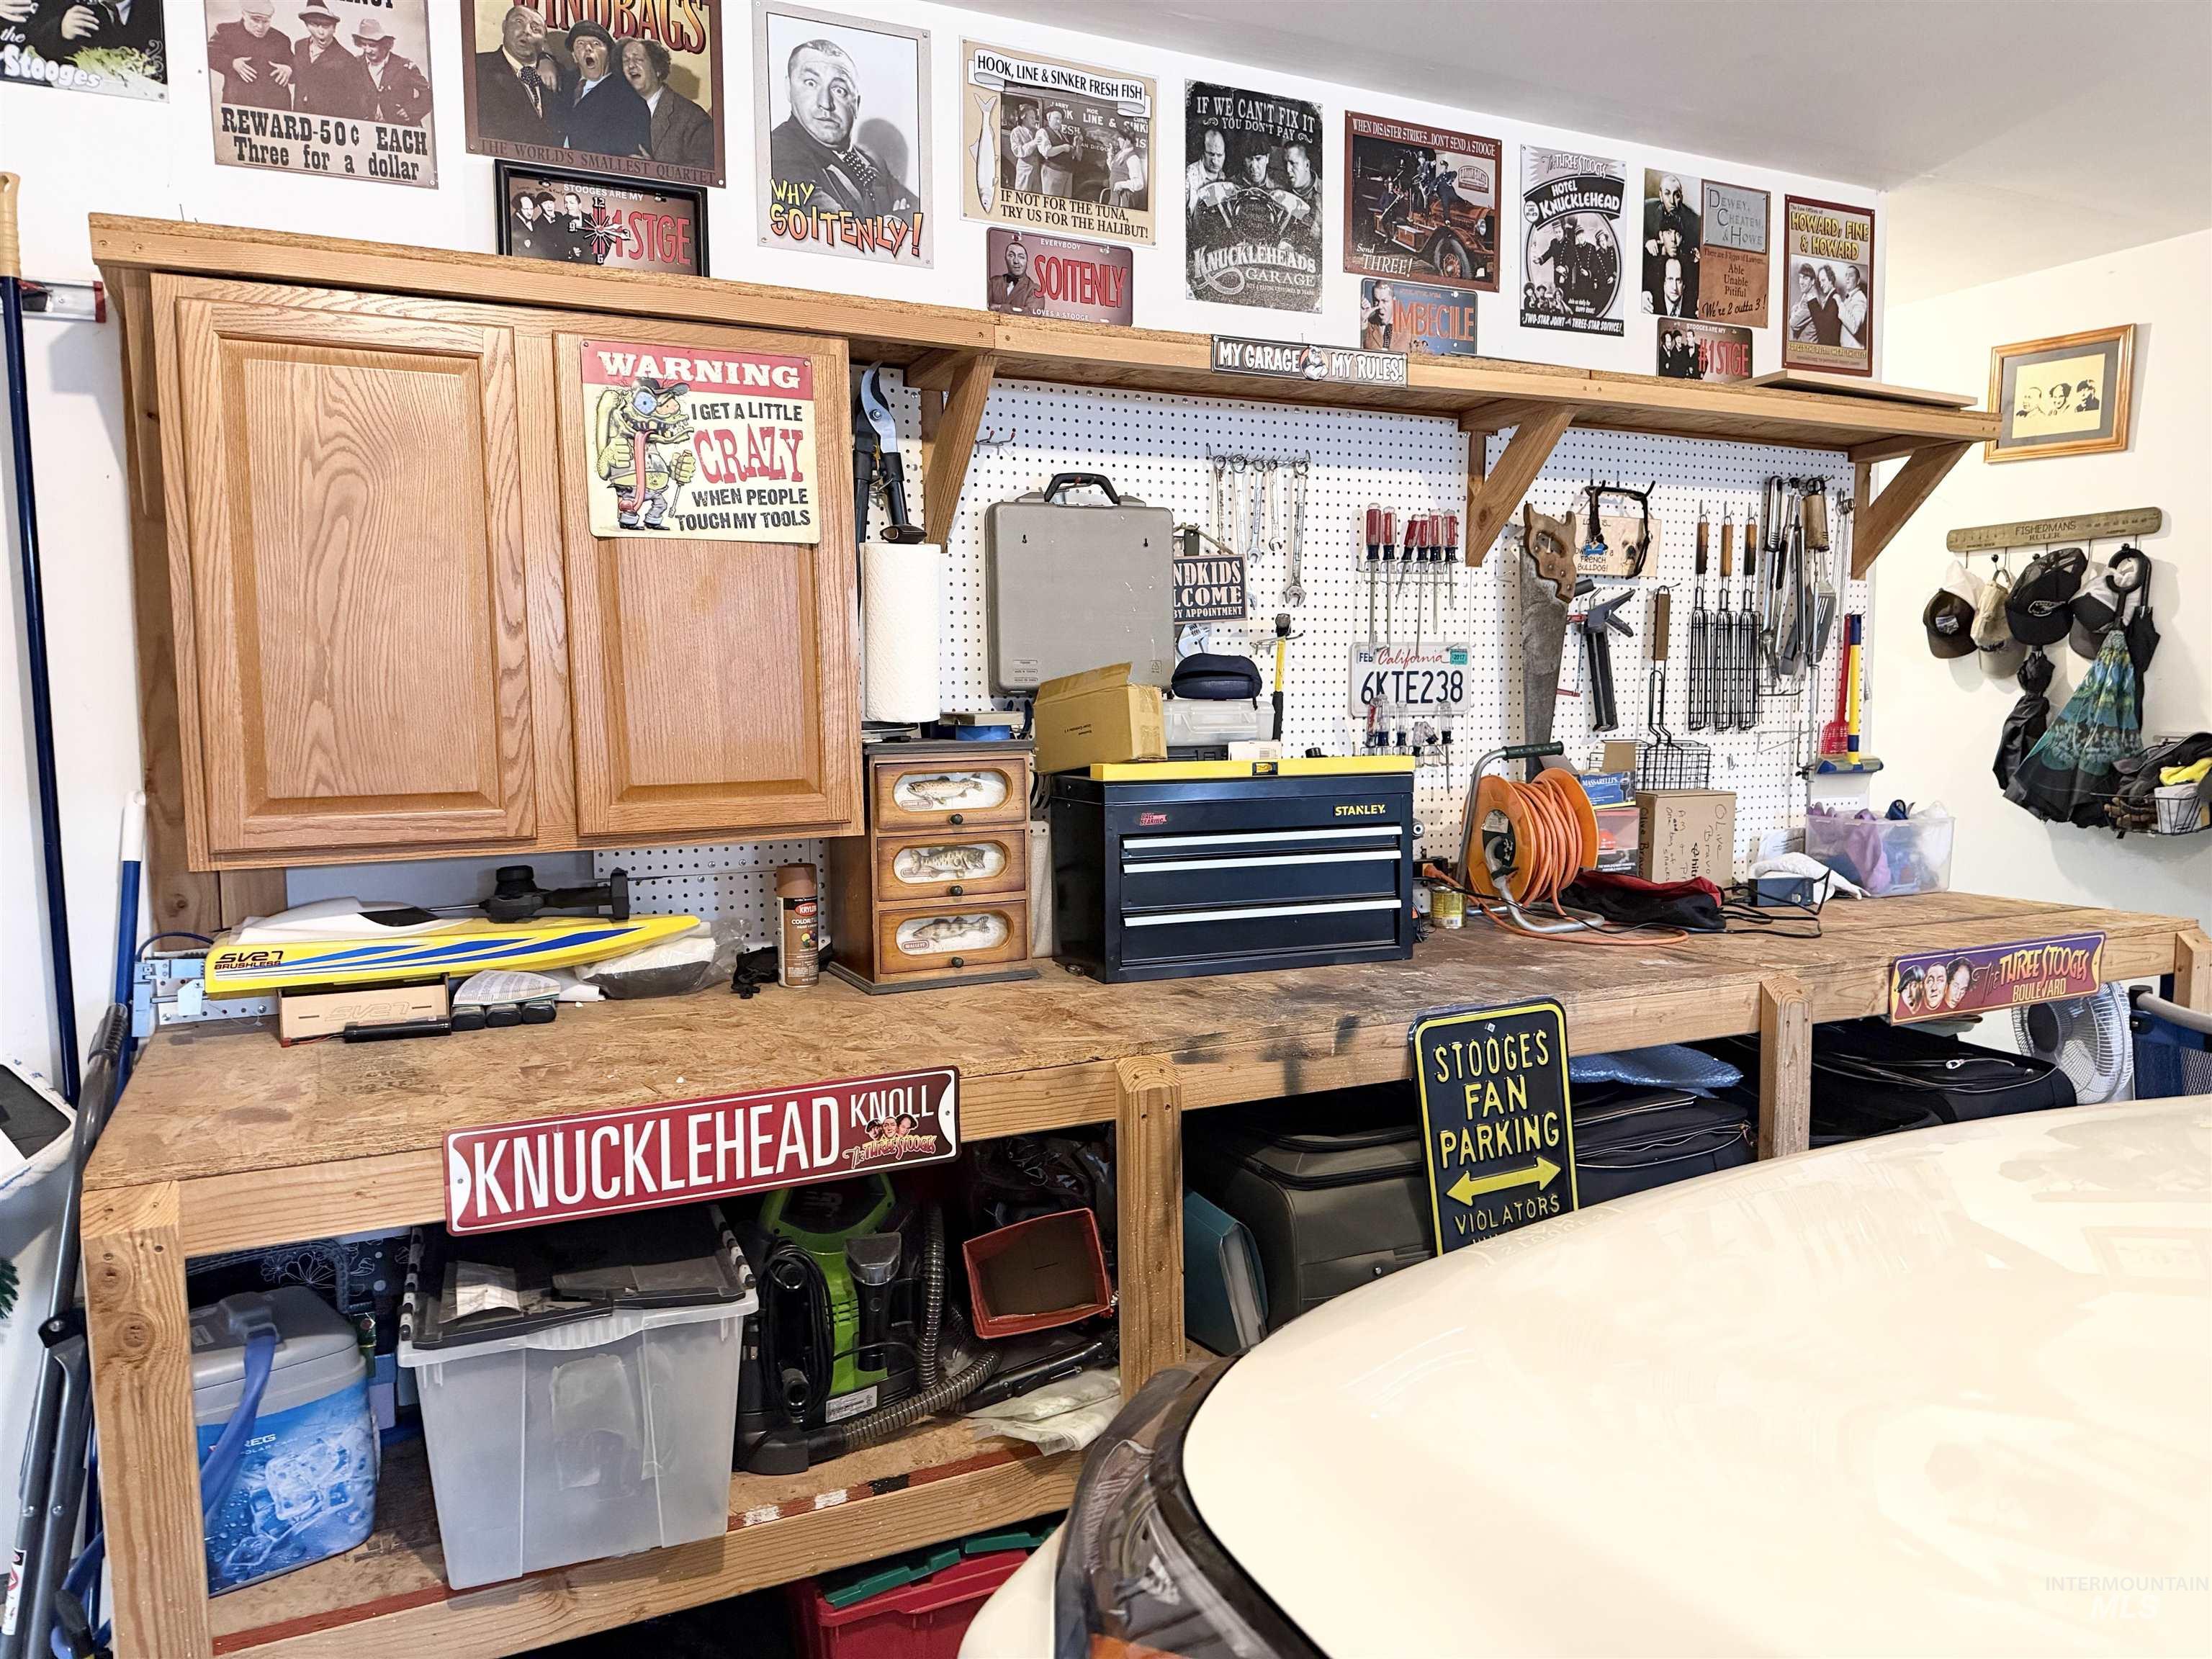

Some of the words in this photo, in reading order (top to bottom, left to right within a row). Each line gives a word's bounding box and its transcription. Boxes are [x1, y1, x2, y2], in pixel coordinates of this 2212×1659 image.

[1, 26, 26, 42] the
[513, 0, 707, 54] INDBAGS
[4, 44, 102, 88] Stooges
[977, 55, 1014, 79] HOOK,
[1017, 64, 1039, 81] LINE
[1041, 69, 1050, 83] &
[1051, 71, 1087, 91] SINKER
[1089, 81, 1118, 97] FRESH
[1121, 84, 1143, 100] FISH
[1083, 113, 1103, 125] LINE
[1196, 96, 1210, 114] IF
[1213, 96, 1233, 117] WE
[1238, 99, 1274, 124] CAN'T
[1278, 107, 1299, 130] FIX
[1303, 114, 1315, 133] IT
[376, 126, 428, 156] EACH
[1221, 117, 1242, 130] YOU
[1245, 120, 1274, 135] DON'T
[1277, 125, 1295, 141] PAY
[1352, 118, 1372, 133] WHEN
[1372, 122, 1402, 139] DISASTER
[1450, 136, 1465, 150] SEND
[1466, 140, 1471, 150] A
[1471, 140, 1495, 156] STOOGE
[234, 136, 289, 166] Three
[303, 145, 330, 170] for
[345, 155, 354, 174] a
[369, 153, 419, 181] dollar
[480, 139, 508, 156] THE
[513, 144, 575, 164] WORLD'S
[581, 154, 649, 176] SMALLEST
[656, 166, 716, 181] QUARTET
[1555, 153, 1578, 169] THREE
[563, 184, 608, 197] STOOGES
[610, 188, 627, 199] ARE
[629, 190, 644, 202] MY
[770, 179, 815, 207] WHY
[1551, 179, 1578, 197] HOTEL
[593, 197, 606, 208] 12
[1001, 190, 1013, 202] IF
[1015, 193, 1040, 207] NOT
[1043, 197, 1066, 211] FOR
[1069, 200, 1092, 215] THE
[1095, 204, 1129, 222] TUNA,
[1539, 192, 1619, 219] KNUCKLEHEAD
[770, 203, 924, 258] SOITENLY!
[1001, 204, 1022, 218] TRY
[1027, 208, 1042, 222] US
[1045, 211, 1068, 227] FOR
[1071, 215, 1094, 230] THE
[1097, 219, 1148, 238] HALIBUT!
[1791, 211, 1842, 238] HOWARD,
[1845, 220, 1869, 242] FINE
[1040, 238, 1081, 250] EVERYBODY
[1357, 243, 1375, 253] Send
[1800, 235, 1809, 253] &
[1812, 236, 1859, 260] HOWARD
[1194, 245, 1316, 279] KNUCKLEHEADS
[1362, 253, 1413, 277] THREE!
[1728, 264, 1744, 274] Able
[1034, 255, 1128, 308] SOITENLY
[1245, 267, 1316, 287] GARAGE
[1724, 274, 1748, 287] Unable
[1725, 285, 1746, 297] Pitiful
[1033, 308, 1054, 318] LOVES
[1062, 312, 1089, 321] STOOGE
[1393, 300, 1475, 341] IMBECILE
[1702, 301, 1725, 317] We're
[1735, 300, 1753, 313] outta
[597, 351, 801, 390] WARNING
[1219, 341, 1244, 367] MY
[1244, 345, 1300, 373] GARAGE
[1331, 351, 1354, 378] MY
[1355, 354, 1405, 382] RULES!
[692, 403, 698, 421] I
[700, 403, 730, 420] GET
[734, 403, 745, 419] A
[748, 402, 803, 422] LITTLE
[693, 423, 804, 484] CRAZY
[692, 488, 742, 508] WHEN
[747, 488, 809, 505] PEOPLE
[675, 511, 732, 531] TOUCH
[734, 511, 757, 529] MY
[760, 510, 811, 528] TOOLS
[1185, 606, 1242, 618] APPOINTMENT
[1377, 647, 1446, 670] California
[1361, 670, 1463, 705] 6KTE238
[1335, 804, 1385, 816] STANLEY
[215, 961, 282, 970] BRUSHLESS
[1999, 949, 2041, 986] THREE
[2041, 944, 2089, 990] STOOGES
[2013, 978, 2066, 1002] BOULEVARD
[1434, 1030, 1549, 1082] STOOGES
[1463, 1074, 1527, 1120] FAN
[475, 1095, 840, 1218] KNUCKLEHEAD
[850, 1084, 934, 1128] KNOLL
[863, 1137, 896, 1160] THREE
[1440, 1112, 1560, 1169] PARKING
[1454, 1192, 1560, 1236] VIOLATORS
